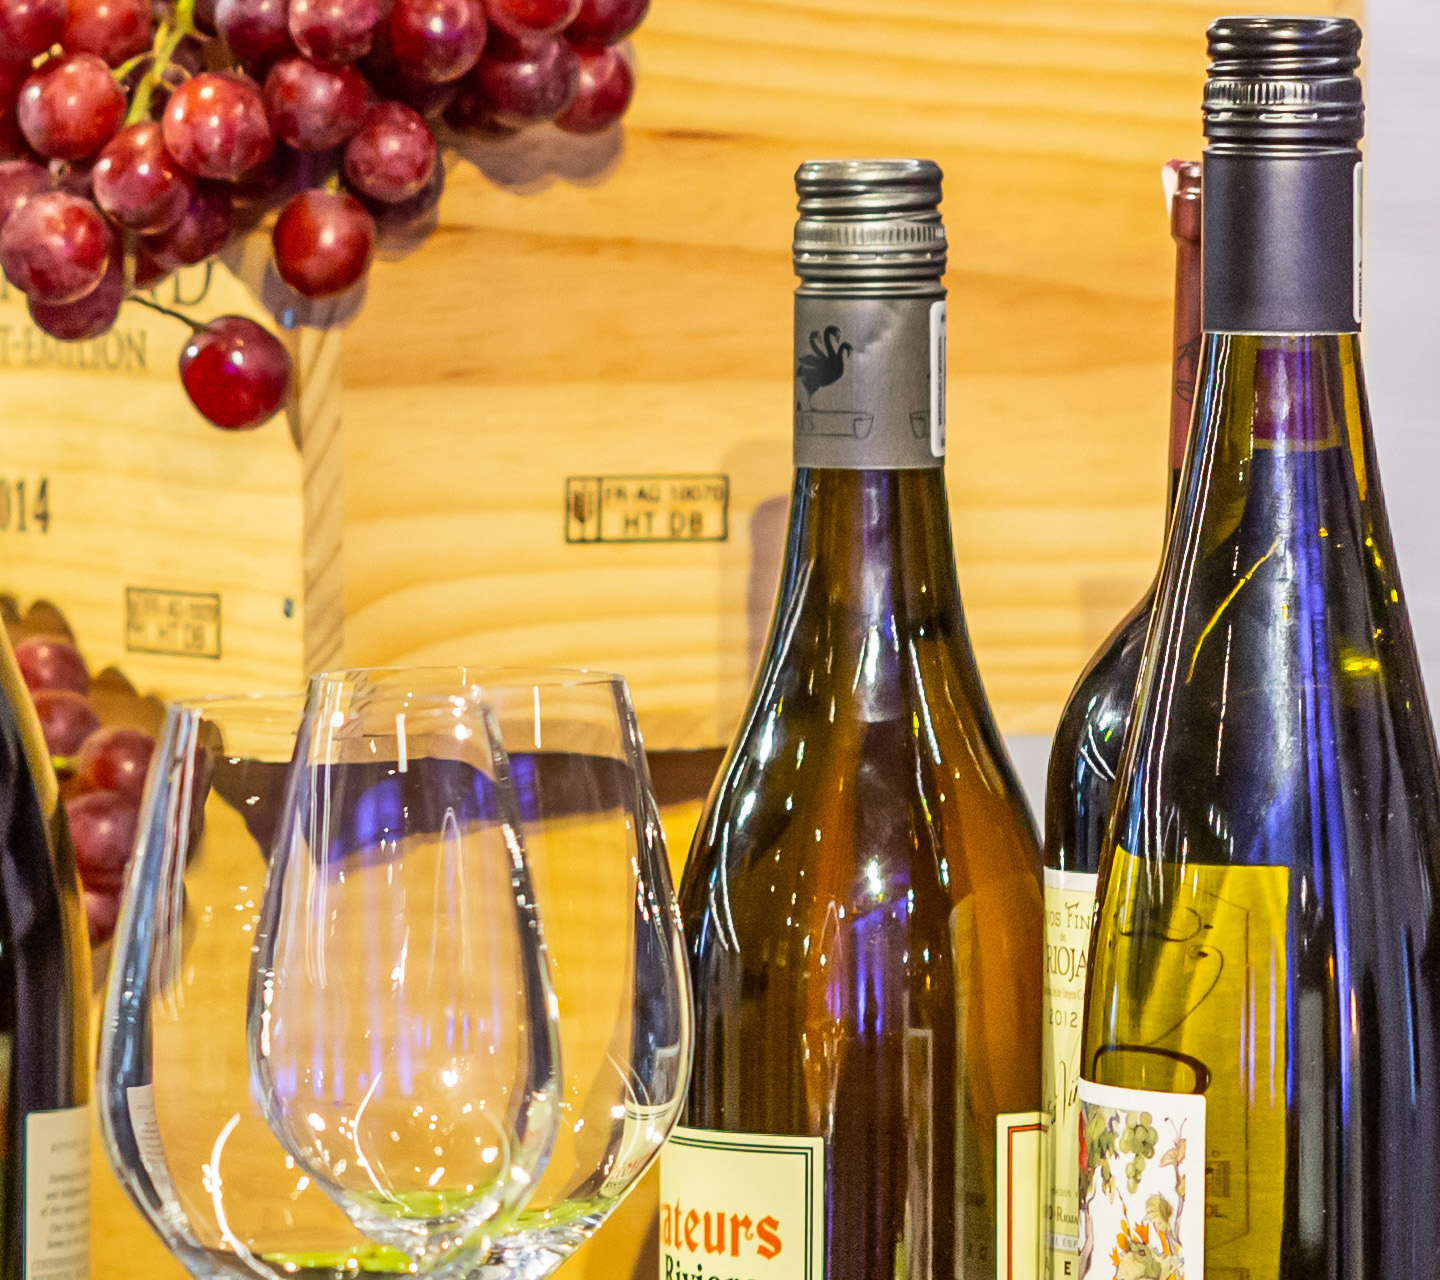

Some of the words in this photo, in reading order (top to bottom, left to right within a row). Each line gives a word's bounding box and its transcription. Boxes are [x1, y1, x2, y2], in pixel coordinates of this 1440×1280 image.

[1046, 943, 1087, 983] RIOJA
[1049, 1008, 1078, 1028] 2012
[661, 1197, 782, 1260] ateurs
